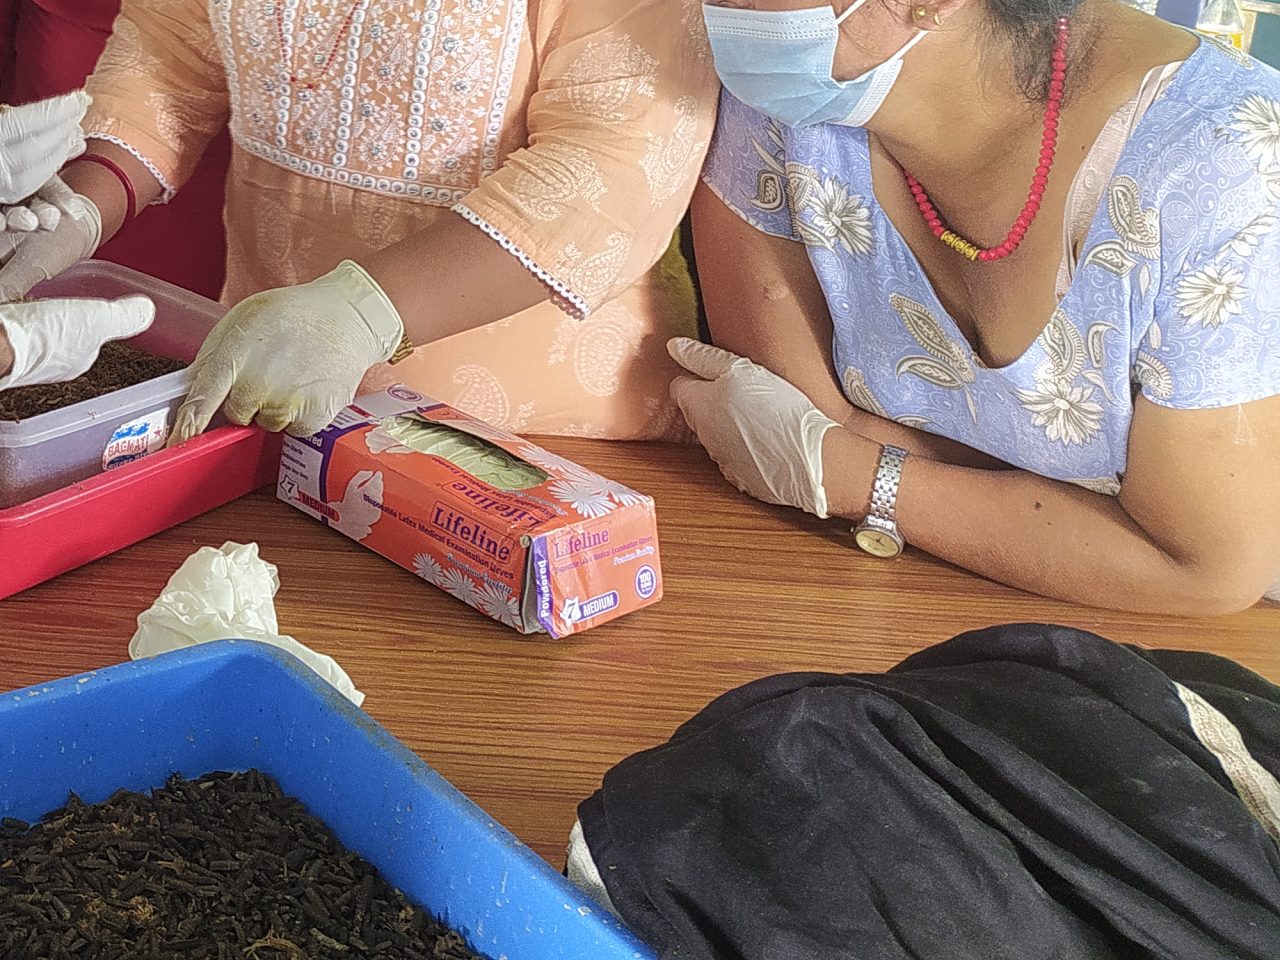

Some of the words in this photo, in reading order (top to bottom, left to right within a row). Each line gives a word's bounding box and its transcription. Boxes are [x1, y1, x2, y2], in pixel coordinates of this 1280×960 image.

[286, 480, 296, 494] 7
[452, 481, 544, 528] Lifeline
[300, 493, 336, 518] MEDIUM
[363, 493, 397, 519] Disposable
[398, 512, 417, 529] Latex
[418, 523, 445, 544] Medical
[446, 537, 490, 567] Examination
[432, 506, 511, 561] Lifeline
[537, 559, 550, 618] Powdered
[639, 571, 652, 583] 100
[567, 601, 576, 619] 7
[582, 594, 615, 617] MEDIUM
